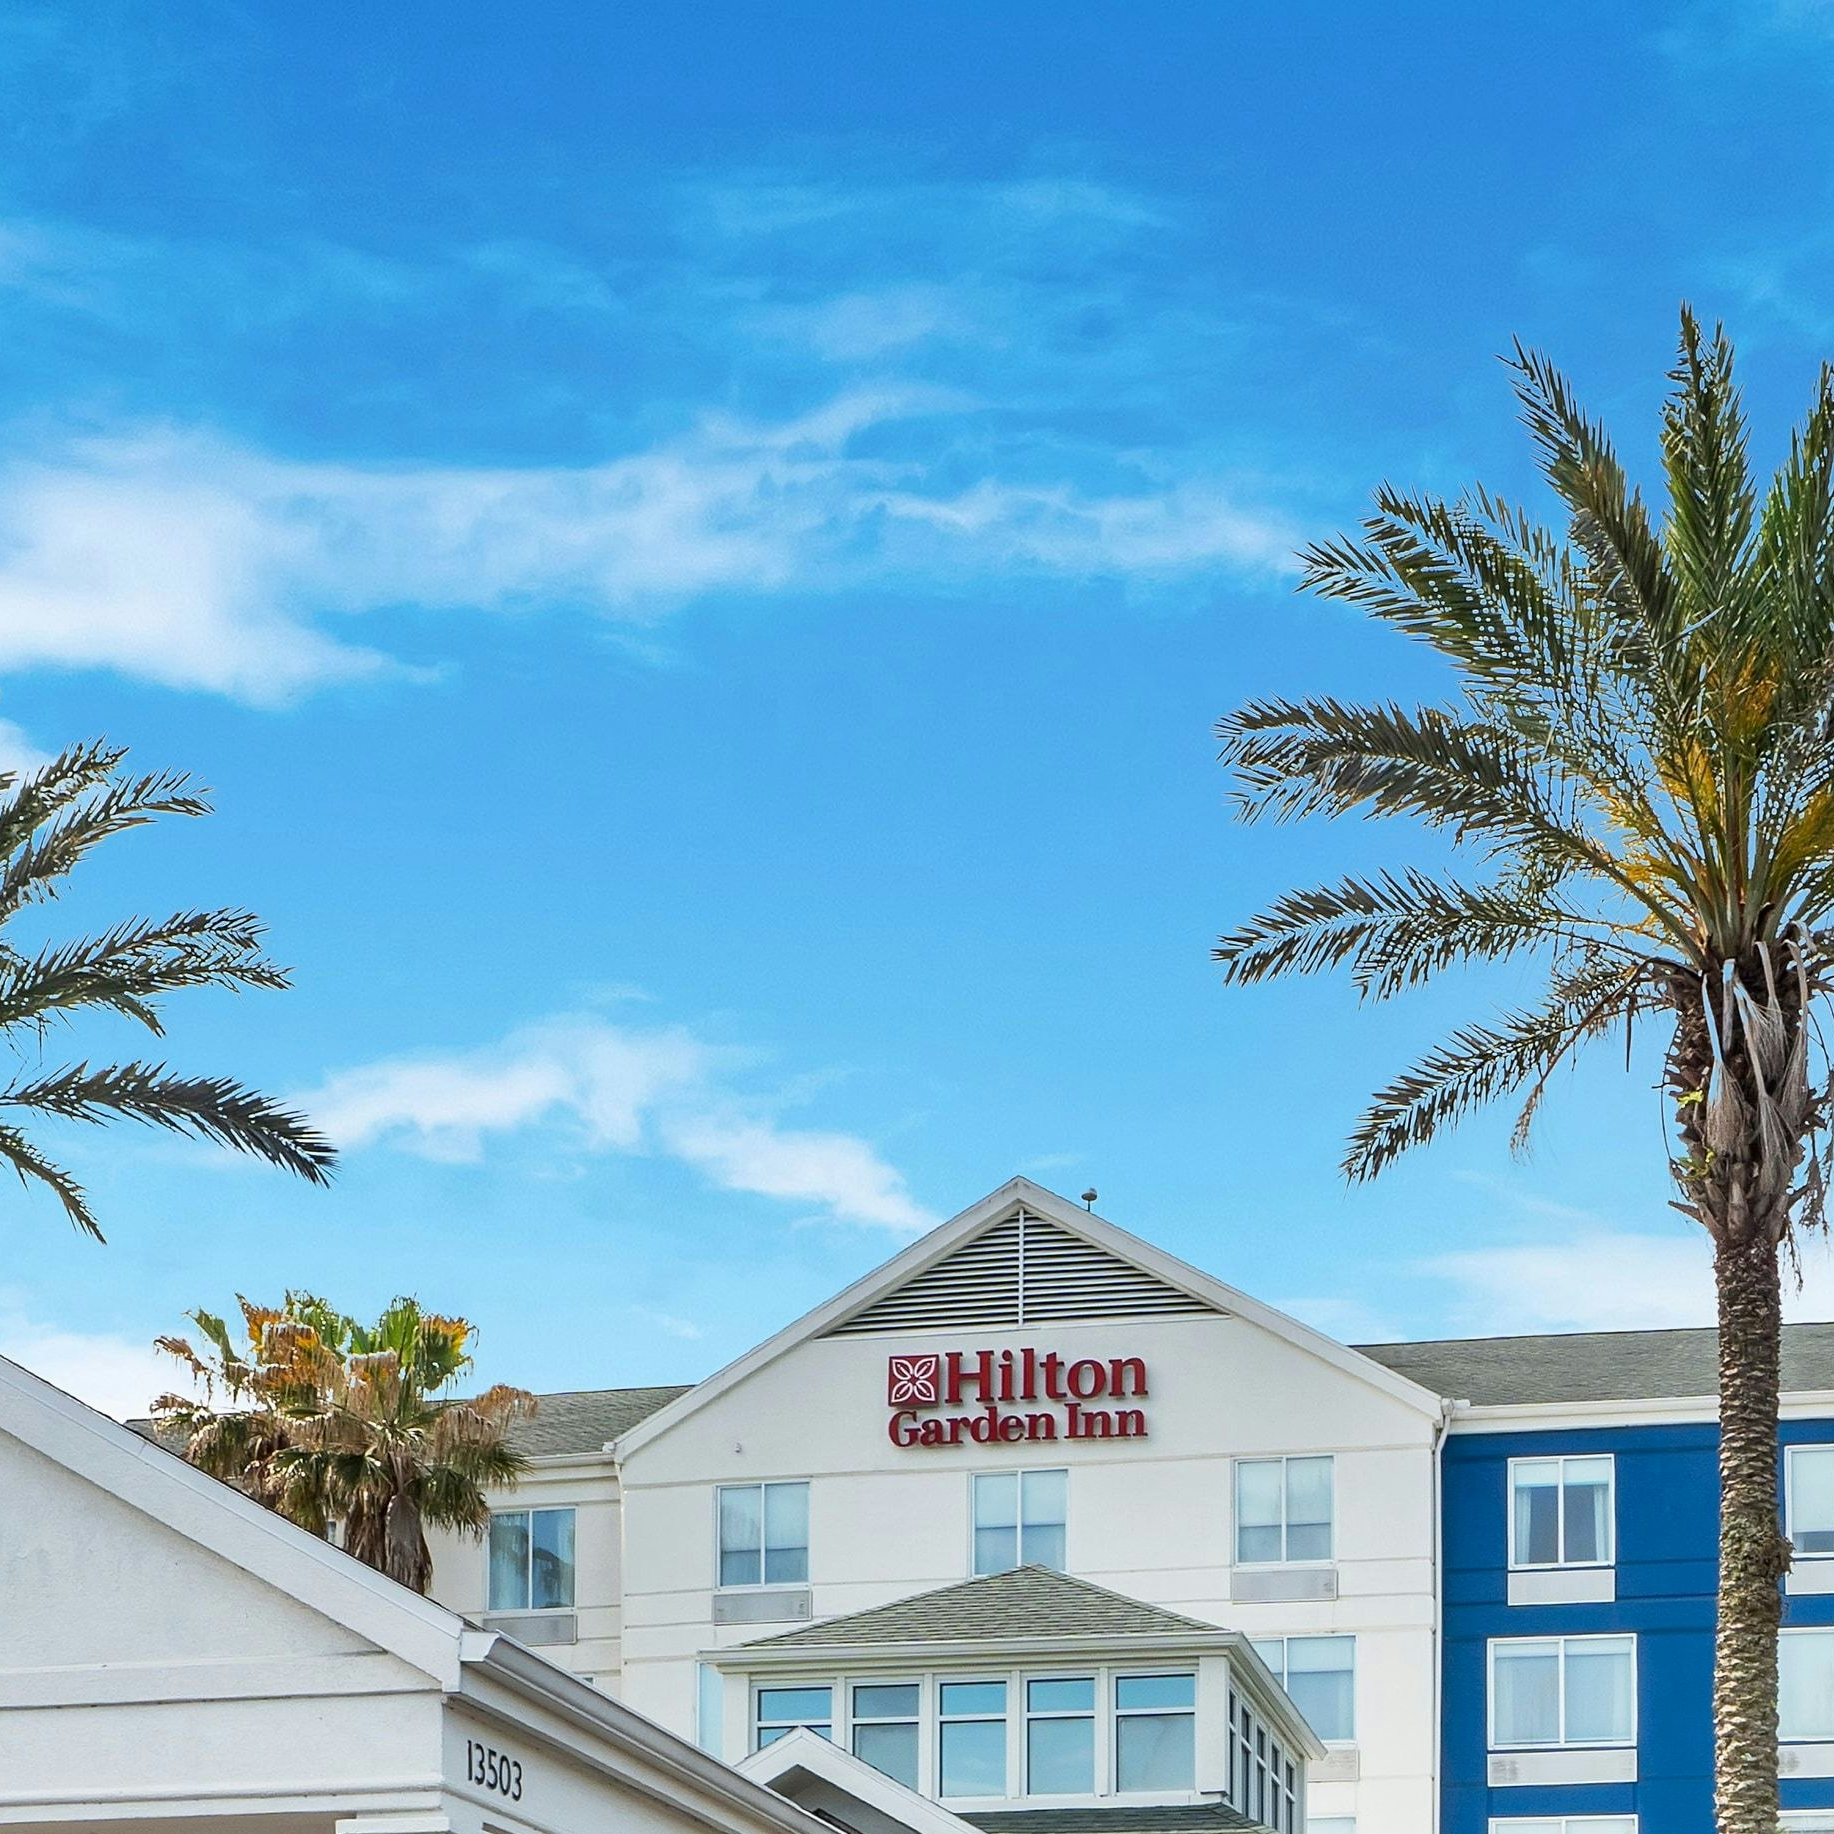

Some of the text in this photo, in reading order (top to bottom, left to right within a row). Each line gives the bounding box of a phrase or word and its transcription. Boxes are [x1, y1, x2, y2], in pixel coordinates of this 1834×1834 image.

[945, 1348, 1149, 1404] Hilton
[888, 1402, 1149, 1447] Garden Inn
[467, 1739, 522, 1802] 13503
